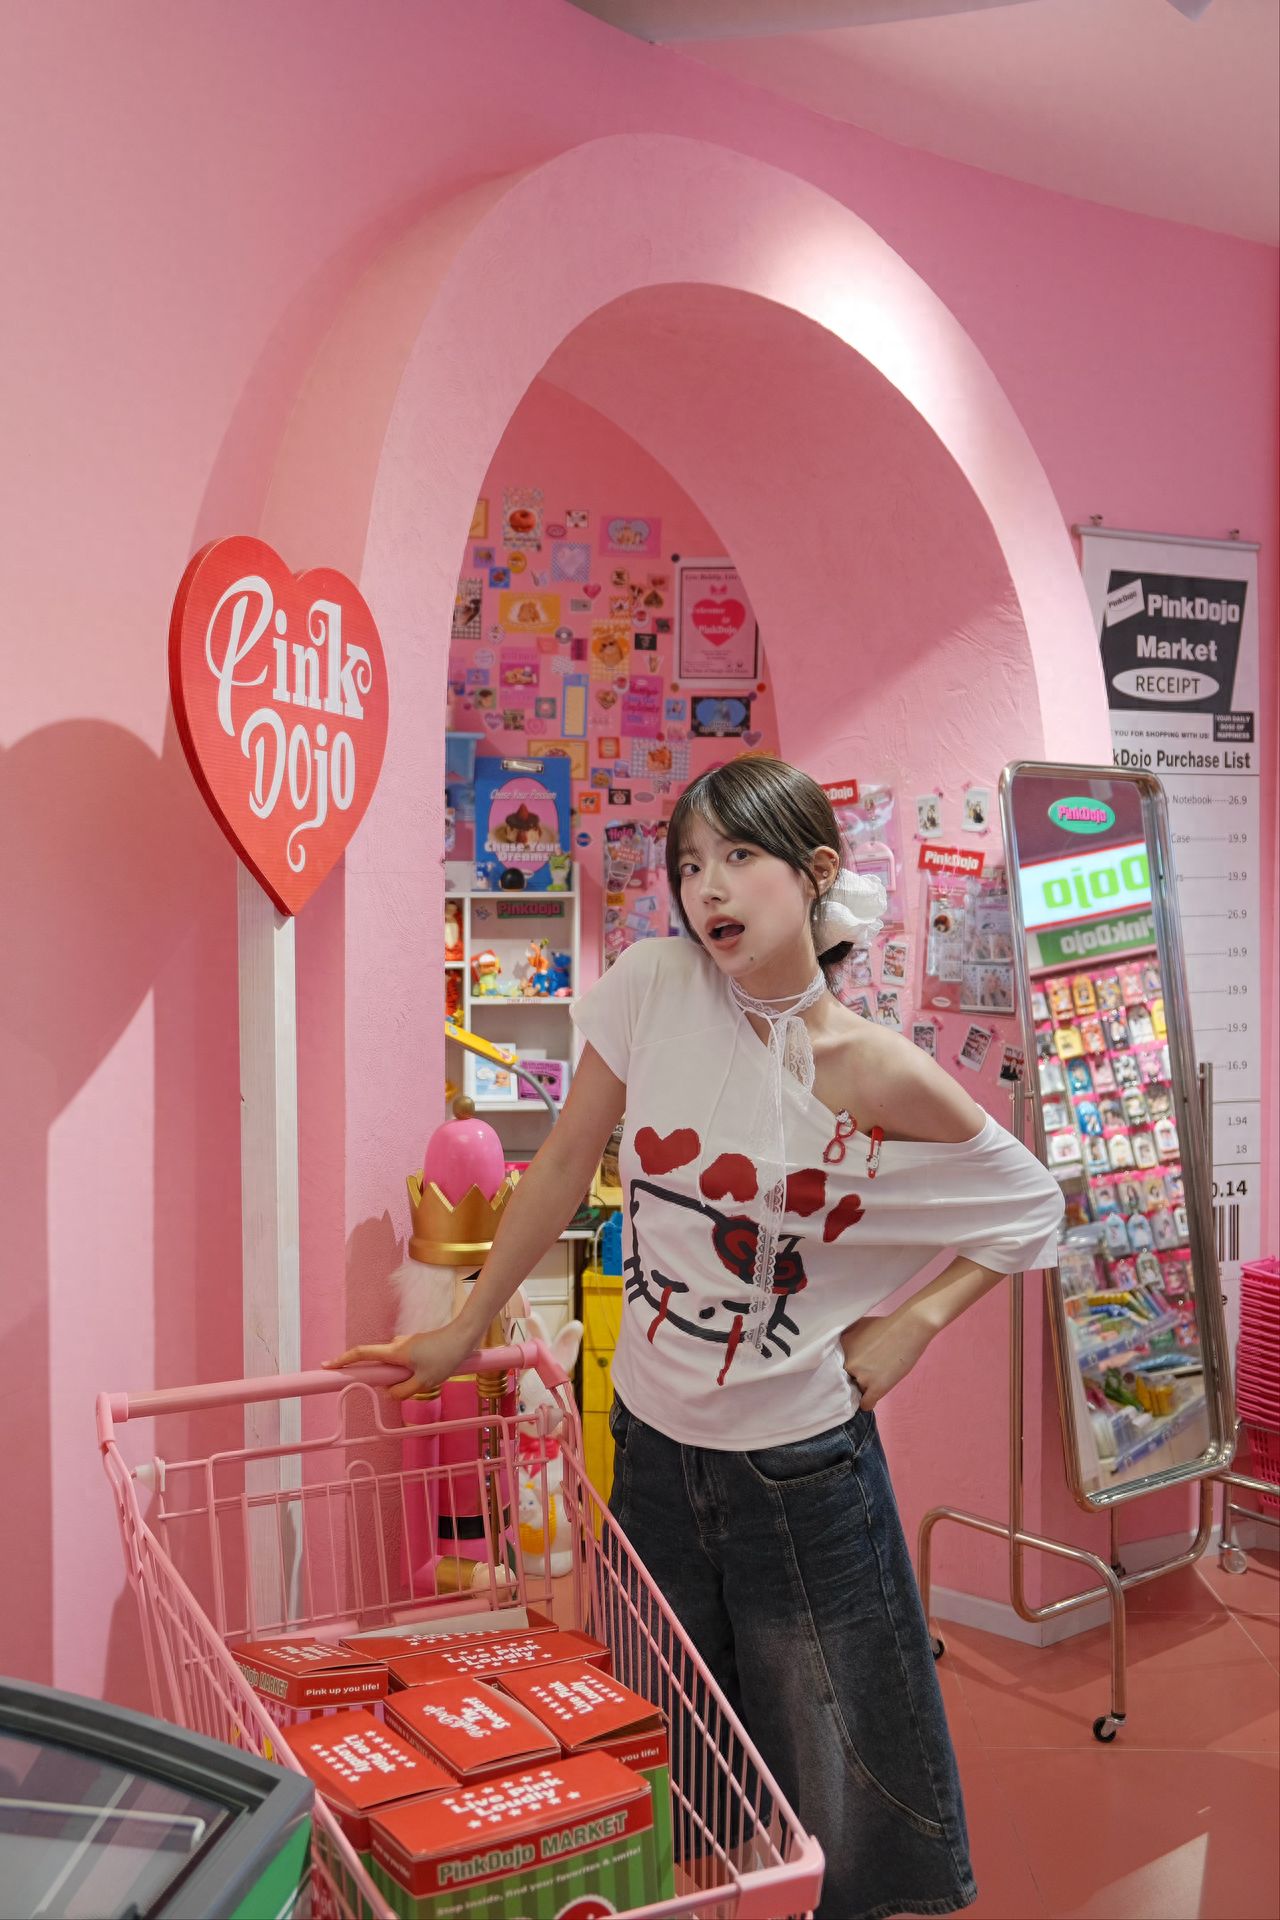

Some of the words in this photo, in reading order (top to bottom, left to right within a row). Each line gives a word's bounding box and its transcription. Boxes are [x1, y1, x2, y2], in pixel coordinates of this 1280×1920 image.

[1108, 591, 1138, 608] PinkDojo
[1147, 594, 1240, 625] PinkDojo
[206, 575, 372, 736] Pink
[1136, 634, 1218, 662] Market
[1136, 676, 1201, 694] RECEIPT
[1217, 731, 1250, 739] HAPPINESS
[1156, 750, 1220, 768] Purchase
[1224, 751, 1251, 769] List
[241, 708, 355, 873] Dojo
[1172, 795, 1213, 805] Notebook
[1228, 795, 1248, 805] 26.9
[1057, 805, 1107, 824] PinkDojo
[1171, 833, 1191, 843] Case
[1227, 834, 1247, 843] 19.9
[924, 850, 980, 870] PinkDojo
[1227, 871, 1247, 881] 19.9
[499, 902, 561, 915] PinkDojo
[1227, 910, 1247, 919] 26.9
[1227, 947, 1248, 957] 19.9
[1227, 985, 1248, 995] 19.9
[1227, 1023, 1248, 1032] 19.9
[1227, 1061, 1248, 1070] 16.9
[1227, 1117, 1248, 1126] 1.94
[1236, 1144, 1248, 1154] 18
[448, 1650, 489, 1664] Live
[494, 1643, 542, 1657] Pink
[465, 1650, 534, 1666] Loudly
[258, 1671, 288, 1699] MARKET
[306, 1688, 327, 1696] Pink
[329, 1687, 341, 1695] up
[343, 1686, 360, 1694] you
[362, 1683, 380, 1691] life!
[549, 1681, 574, 1698] Pink
[570, 1681, 606, 1705] Loudly
[569, 1695, 594, 1715] Live
[332, 1744, 373, 1772] Loudly
[343, 1734, 371, 1754] Live
[365, 1752, 396, 1774] Pink
[621, 1751, 639, 1764] you
[640, 1747, 660, 1758] life!
[450, 1795, 505, 1815] Live
[507, 1777, 564, 1798] Pink
[474, 1788, 557, 1817] Loudly
[437, 1844, 535, 1886] PinkDojo
[540, 1810, 629, 1858] MARKET
[505, 1886, 528, 1898] find
[529, 1878, 554, 1892] your
[556, 1863, 600, 1883] favorites
